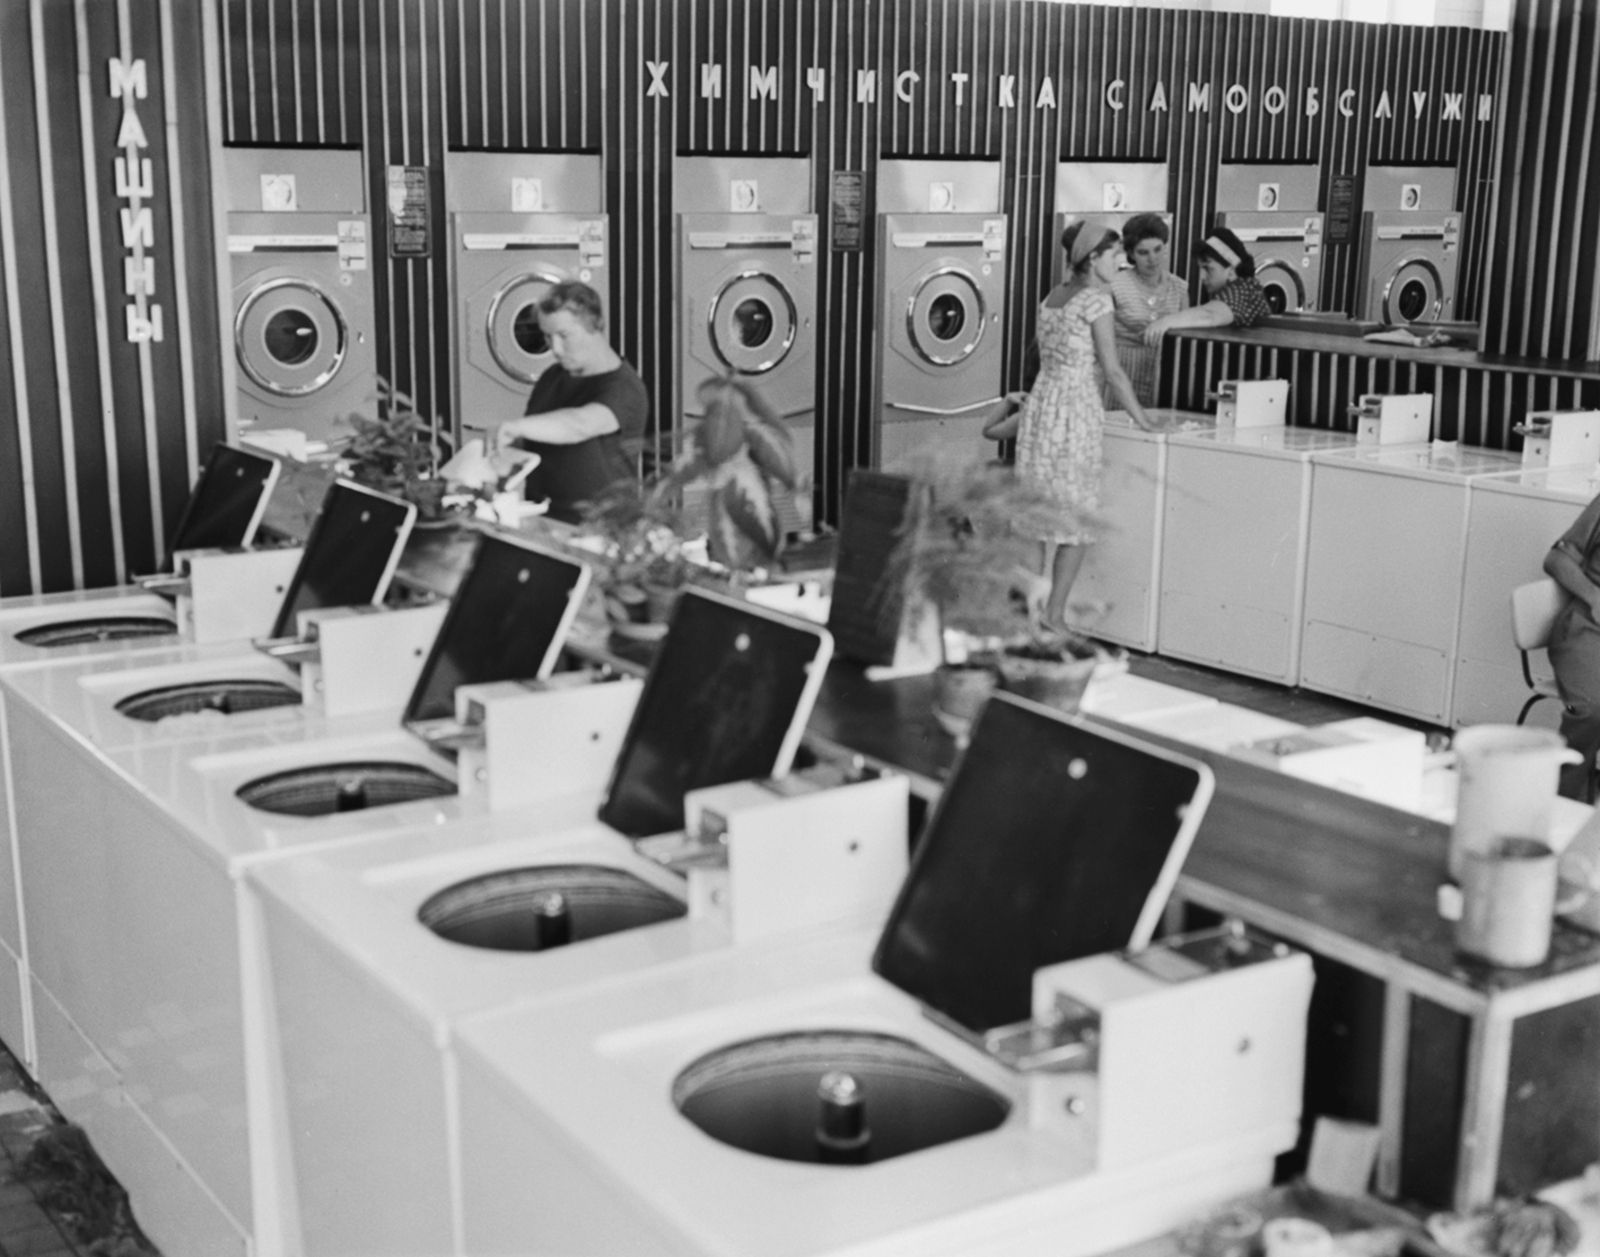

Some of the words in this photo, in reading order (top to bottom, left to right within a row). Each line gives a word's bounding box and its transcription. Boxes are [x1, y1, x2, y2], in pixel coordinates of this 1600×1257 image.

[645, 60, 1057, 109] ХИМЧИСТКА
[1106, 79, 1492, 121] САМООБСЛУЖИ
[109, 57, 163, 342] МАШИНЫ
